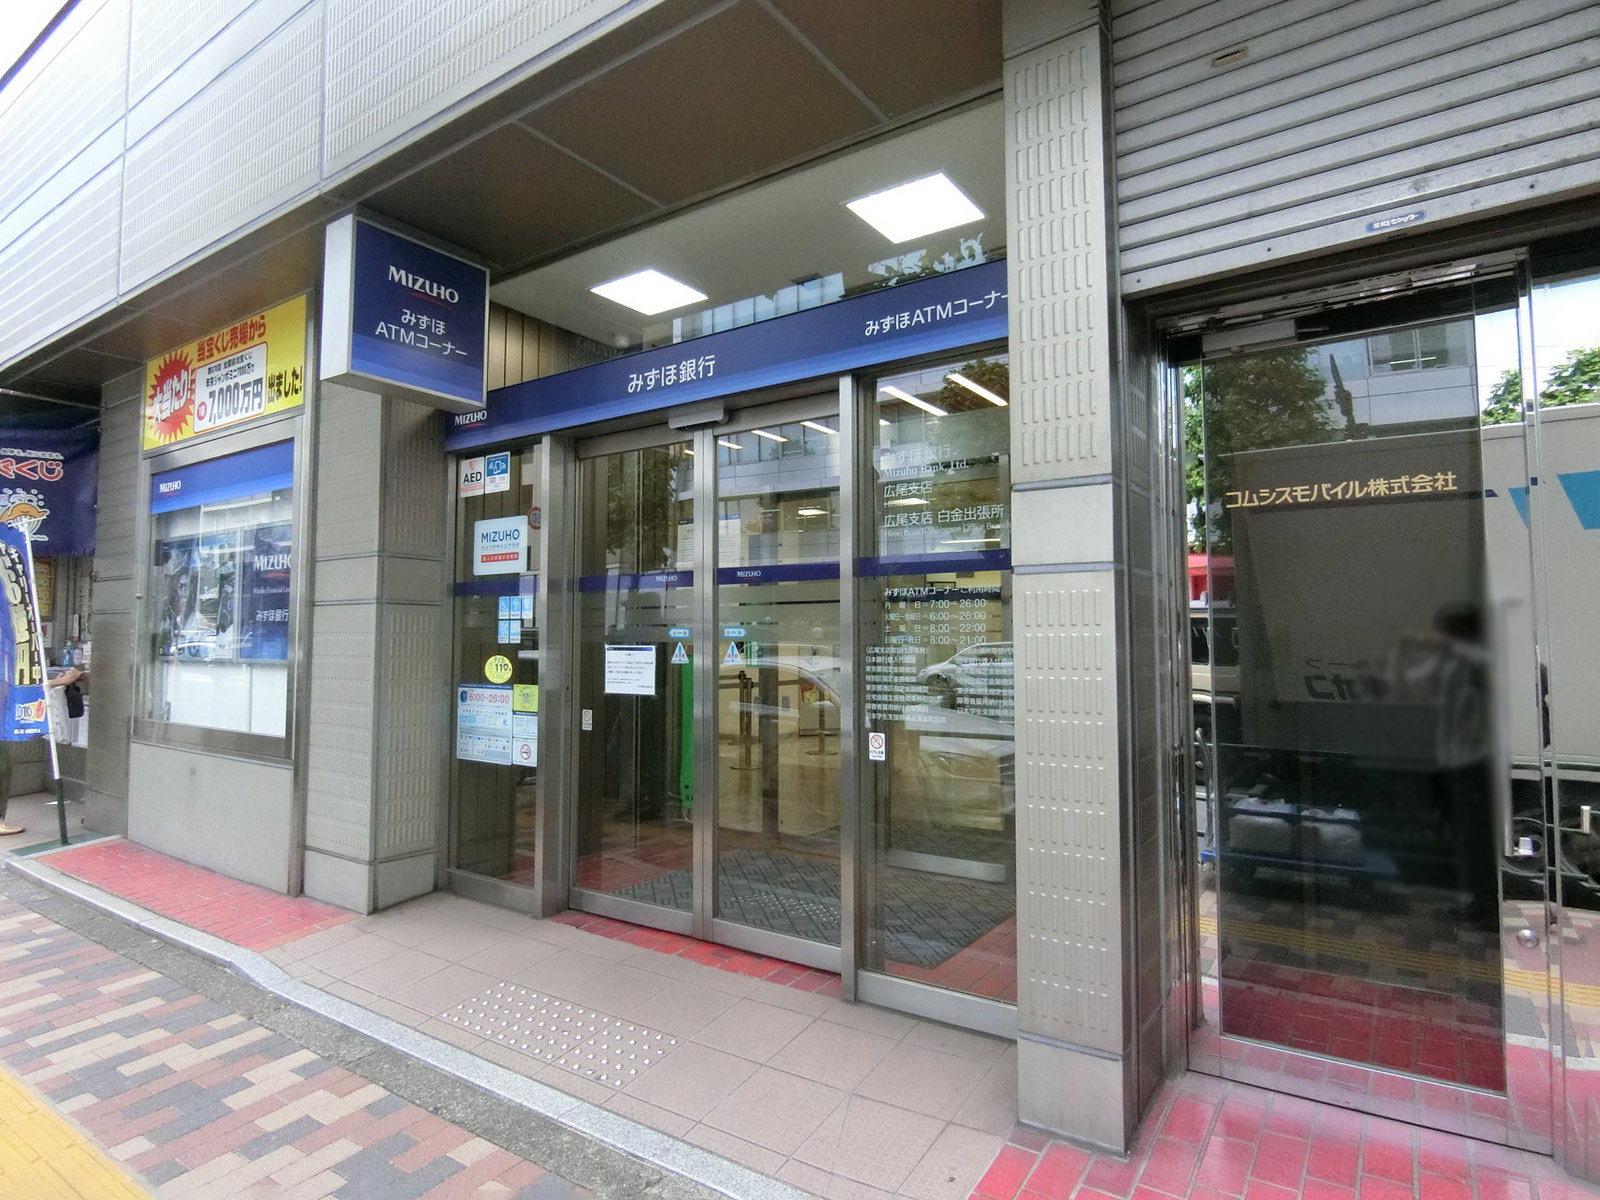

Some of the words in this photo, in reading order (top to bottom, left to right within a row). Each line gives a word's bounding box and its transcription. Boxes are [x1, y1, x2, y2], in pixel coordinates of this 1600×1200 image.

[388, 264, 460, 304] MIZUHO
[401, 308, 446, 335] みずほ
[197, 315, 266, 362] 当宝くじ売場から
[375, 321, 468, 356] ATMコーナー
[627, 354, 716, 394] みずほ銀行
[454, 410, 487, 426] MIZUHO
[463, 471, 482, 485] AED
[884, 466, 918, 478] Mizuho
[159, 480, 182, 493] MIZUHO
[883, 480, 933, 498] 広尾支店
[1225, 470, 1458, 509] コムシスモバイル株式会社
[883, 511, 933, 527] 広尾支店
[938, 503, 1004, 523] 白金出張所
[481, 529, 520, 543] MIZUHO
